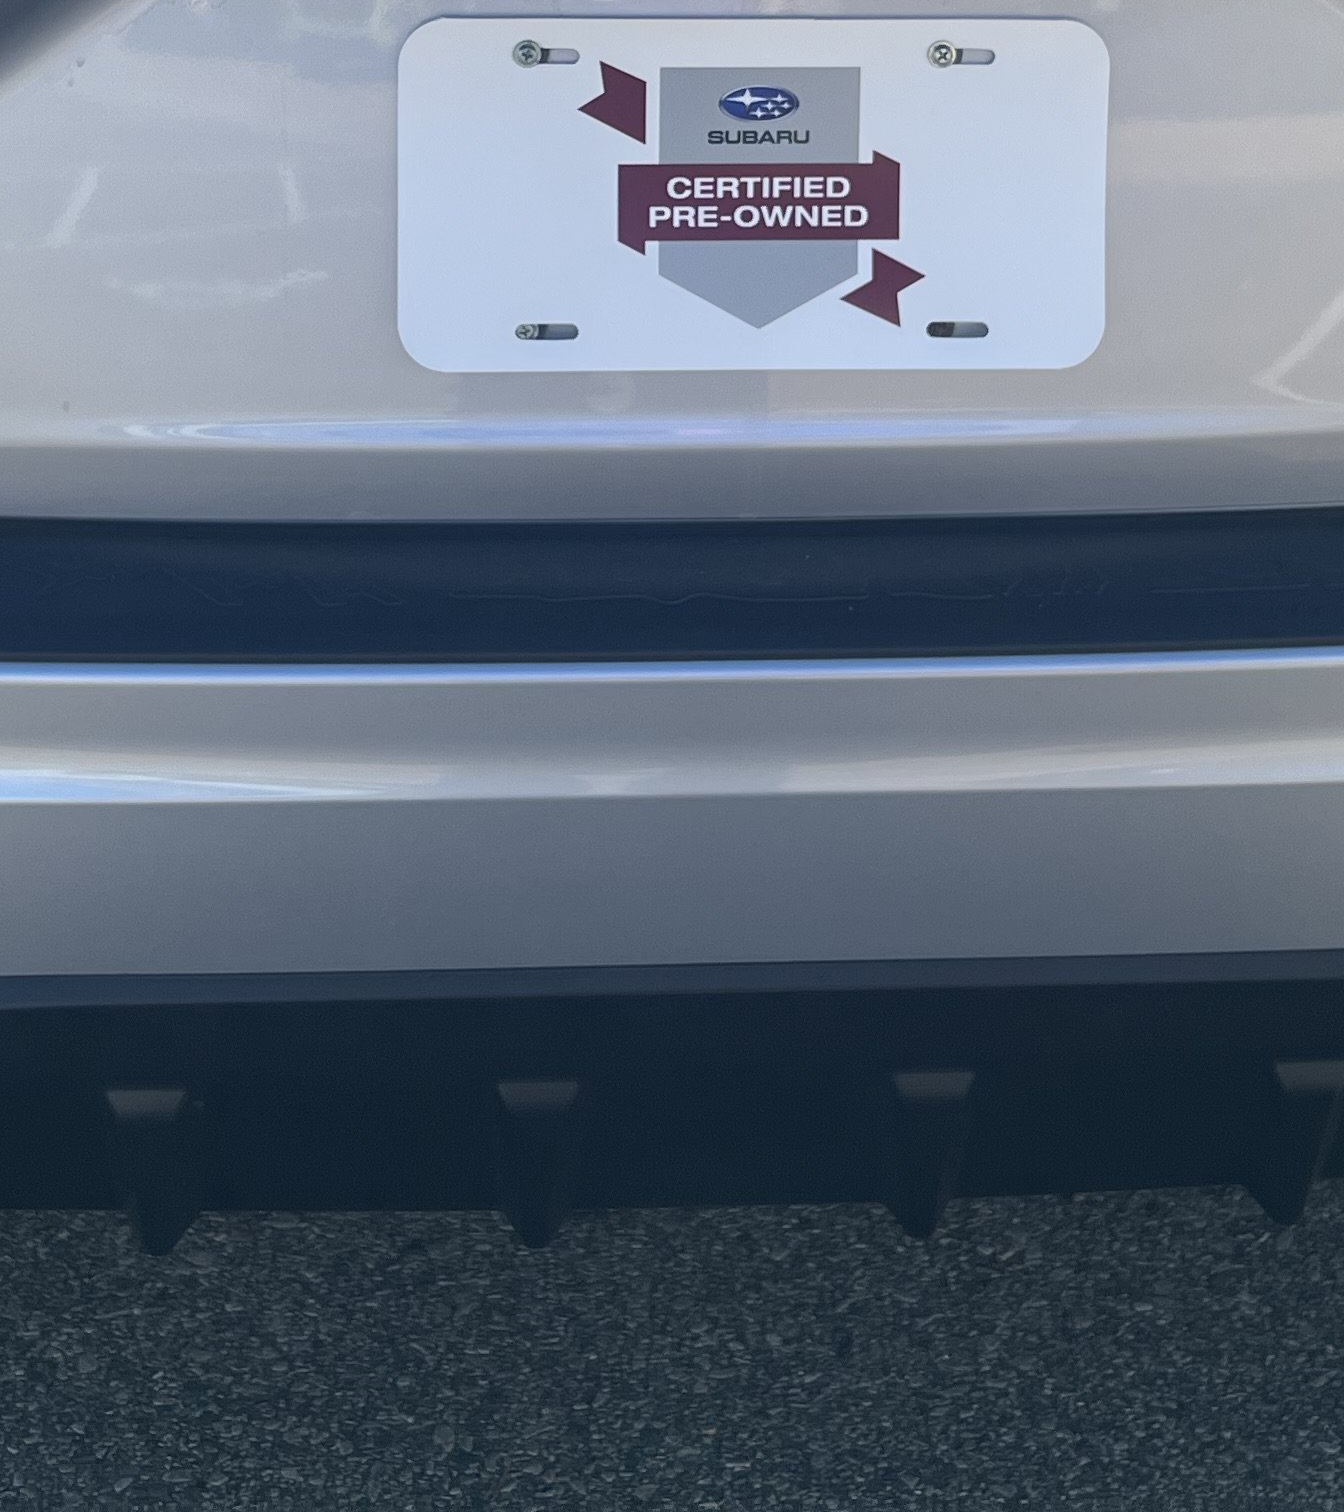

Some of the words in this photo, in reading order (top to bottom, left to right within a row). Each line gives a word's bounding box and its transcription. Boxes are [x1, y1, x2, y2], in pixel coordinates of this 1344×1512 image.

[707, 130, 811, 146] SUBARU
[666, 176, 851, 200] CERTIFIED
[648, 204, 869, 229] PRE-OWNED
